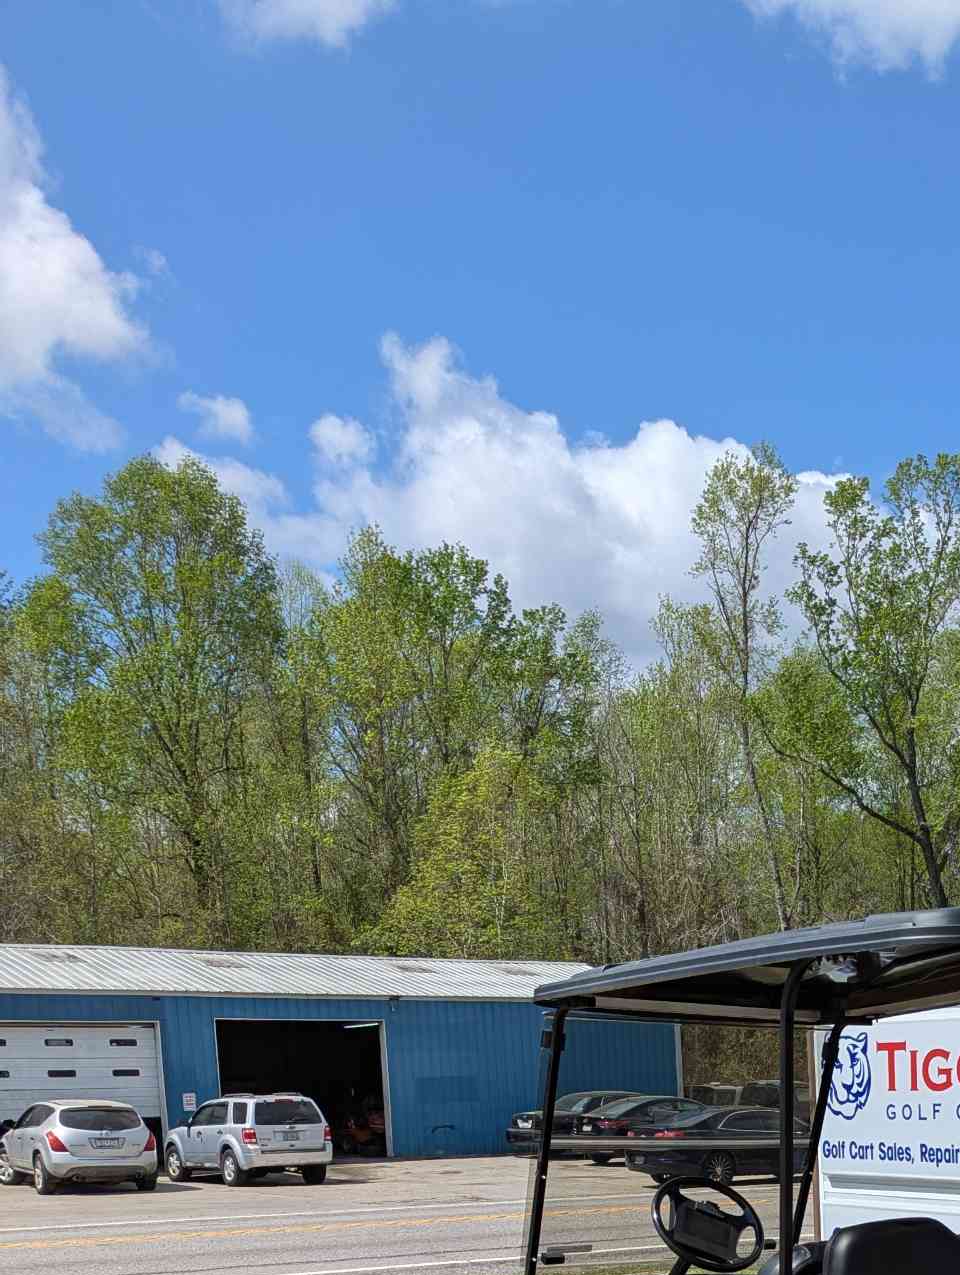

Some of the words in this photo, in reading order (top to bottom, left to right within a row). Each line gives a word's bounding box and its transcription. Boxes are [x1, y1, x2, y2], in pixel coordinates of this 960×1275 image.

[886, 1103, 942, 1121] GOLF
[822, 1140, 845, 1160] Golf
[849, 1141, 874, 1161] Cart
[878, 1142, 914, 1164] Sales,
